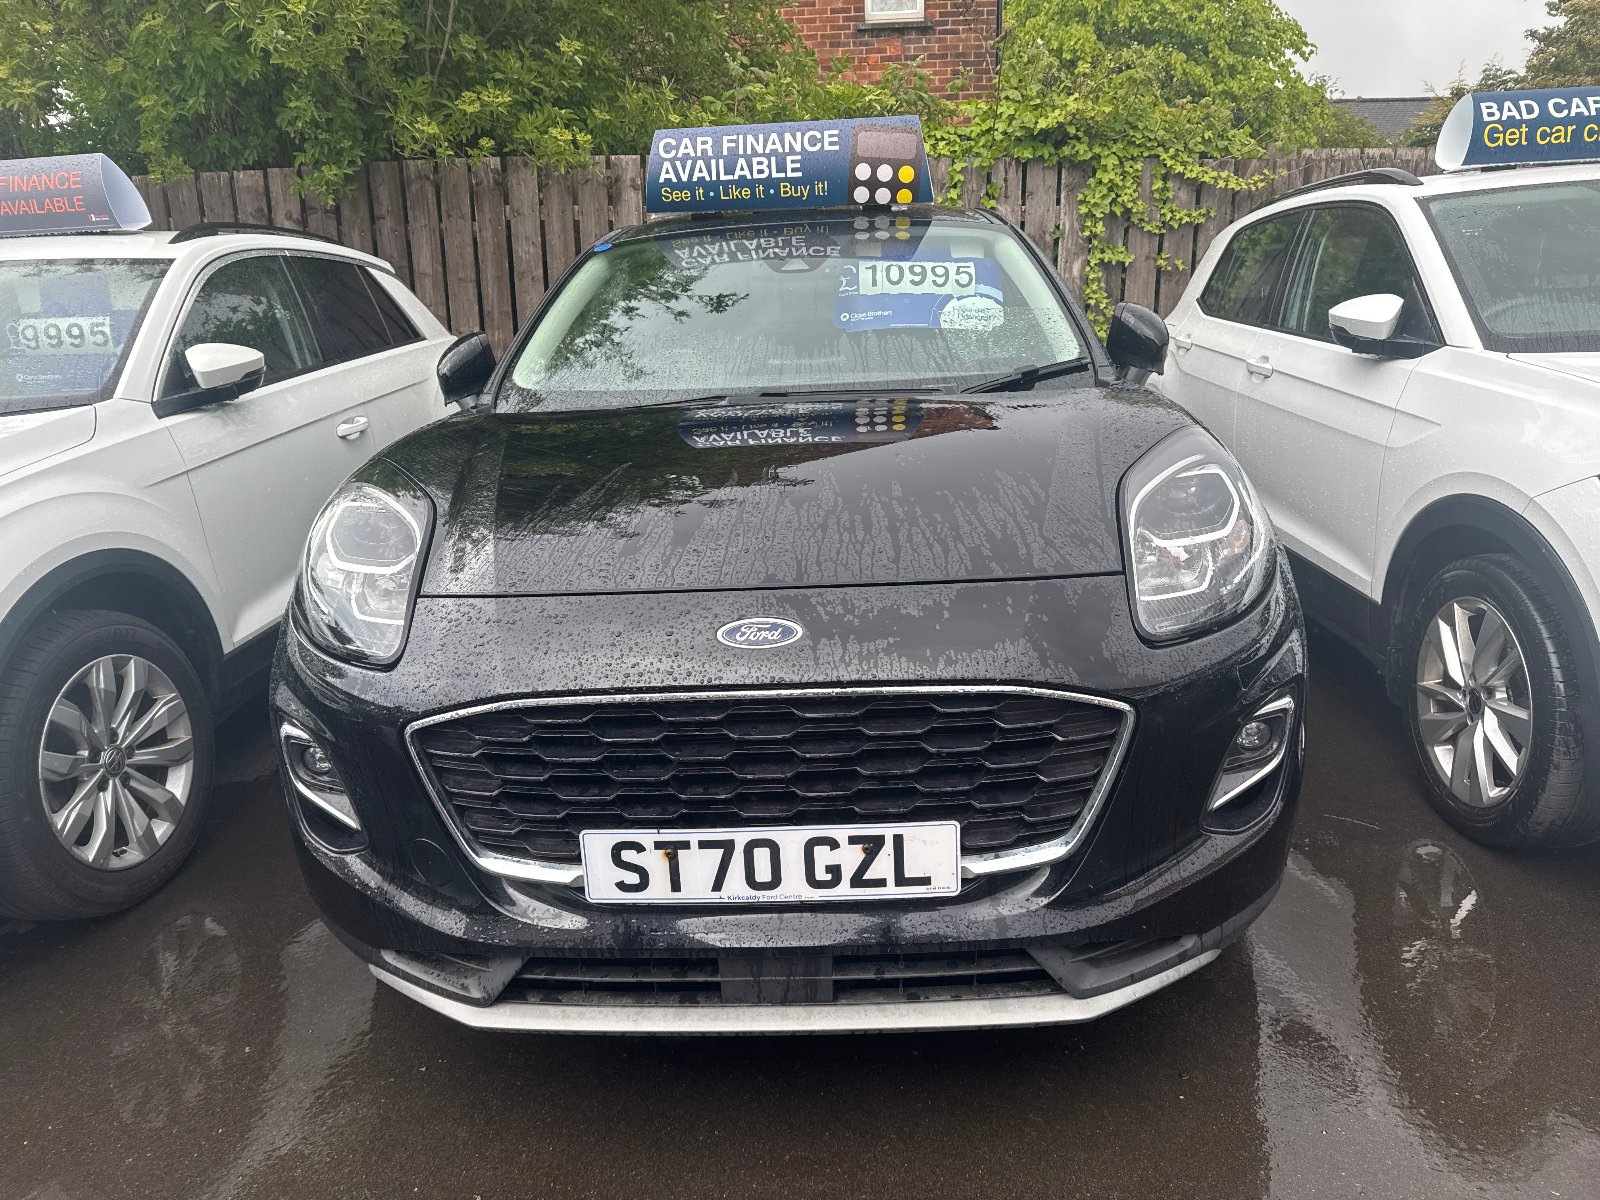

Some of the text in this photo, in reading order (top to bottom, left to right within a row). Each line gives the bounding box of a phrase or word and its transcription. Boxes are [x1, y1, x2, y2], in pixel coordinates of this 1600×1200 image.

[1480, 100, 1539, 121] BAD
[659, 130, 839, 158] CAR FINANCE
[1484, 124, 1600, 147] Get car c
[659, 155, 802, 183] AVAILABLE
[661, 181, 828, 204] See it Like it Buy it!
[1, 196, 85, 215] AVAILABLE
[865, 265, 973, 288] 10995
[21, 322, 109, 350] 9995
[736, 624, 782, 640] Ford
[611, 834, 931, 893] ST70 GZL
